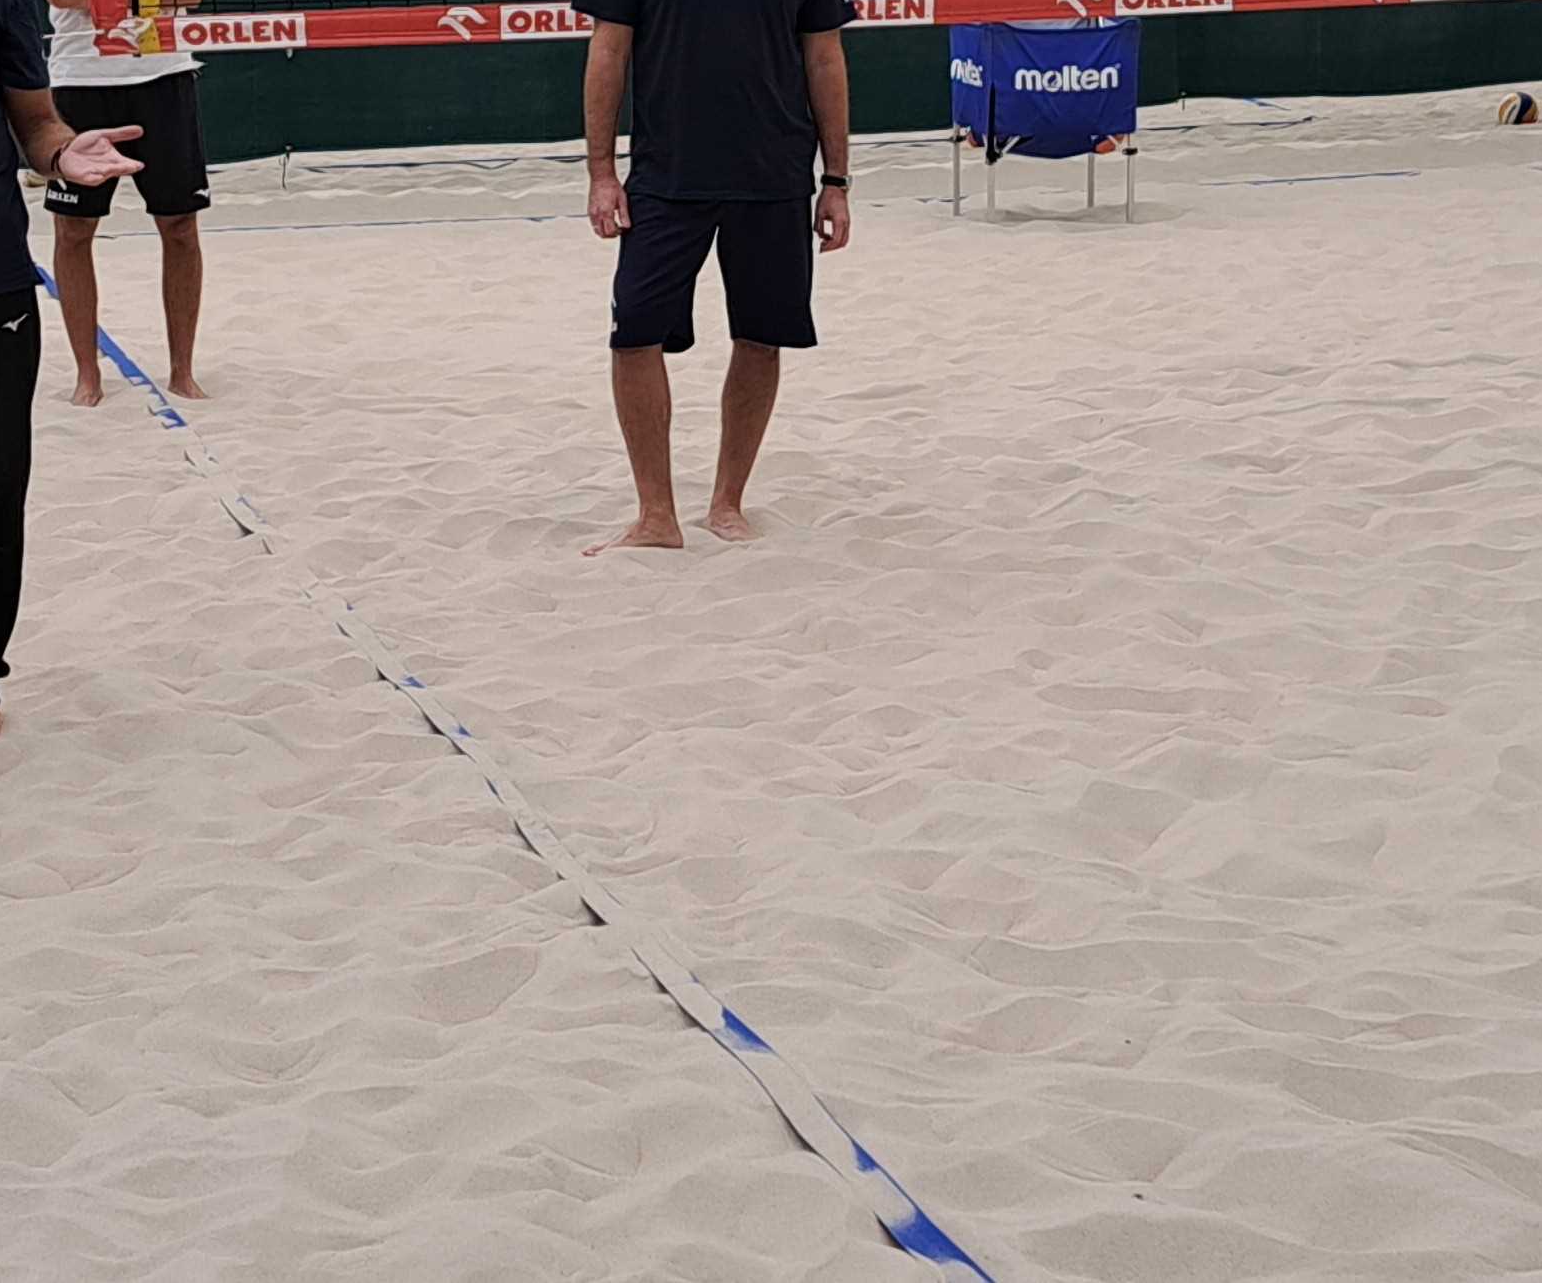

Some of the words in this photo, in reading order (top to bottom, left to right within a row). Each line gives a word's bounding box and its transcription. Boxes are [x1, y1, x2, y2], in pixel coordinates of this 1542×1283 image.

[180, 20, 300, 46] ORLEN
[506, 8, 594, 35] ORLE
[1014, 65, 1120, 93] molten
